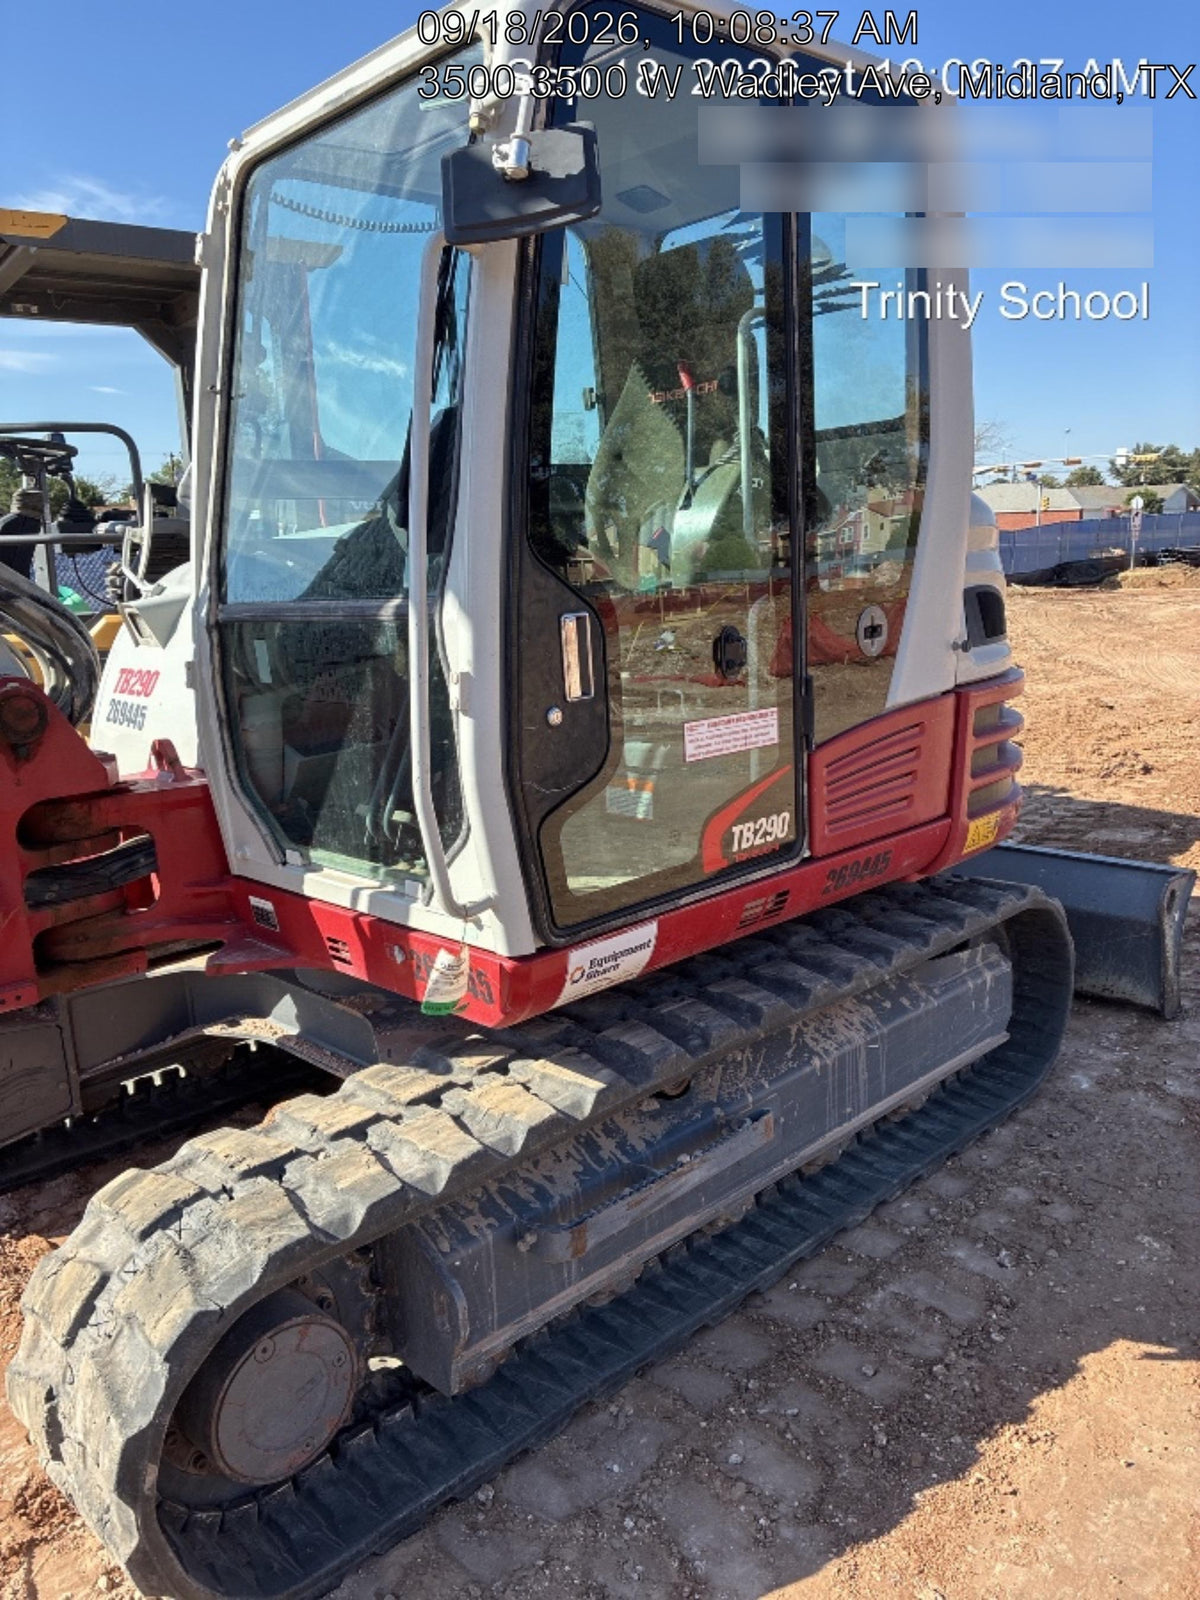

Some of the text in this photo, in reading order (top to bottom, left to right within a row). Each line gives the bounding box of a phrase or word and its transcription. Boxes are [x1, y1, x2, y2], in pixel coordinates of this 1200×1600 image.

[113, 667, 160, 697] TB290
[106, 698, 148, 731] 269445
[731, 811, 790, 853] TB290
[588, 938, 652, 970] Equipment
[585, 963, 621, 982] Share
